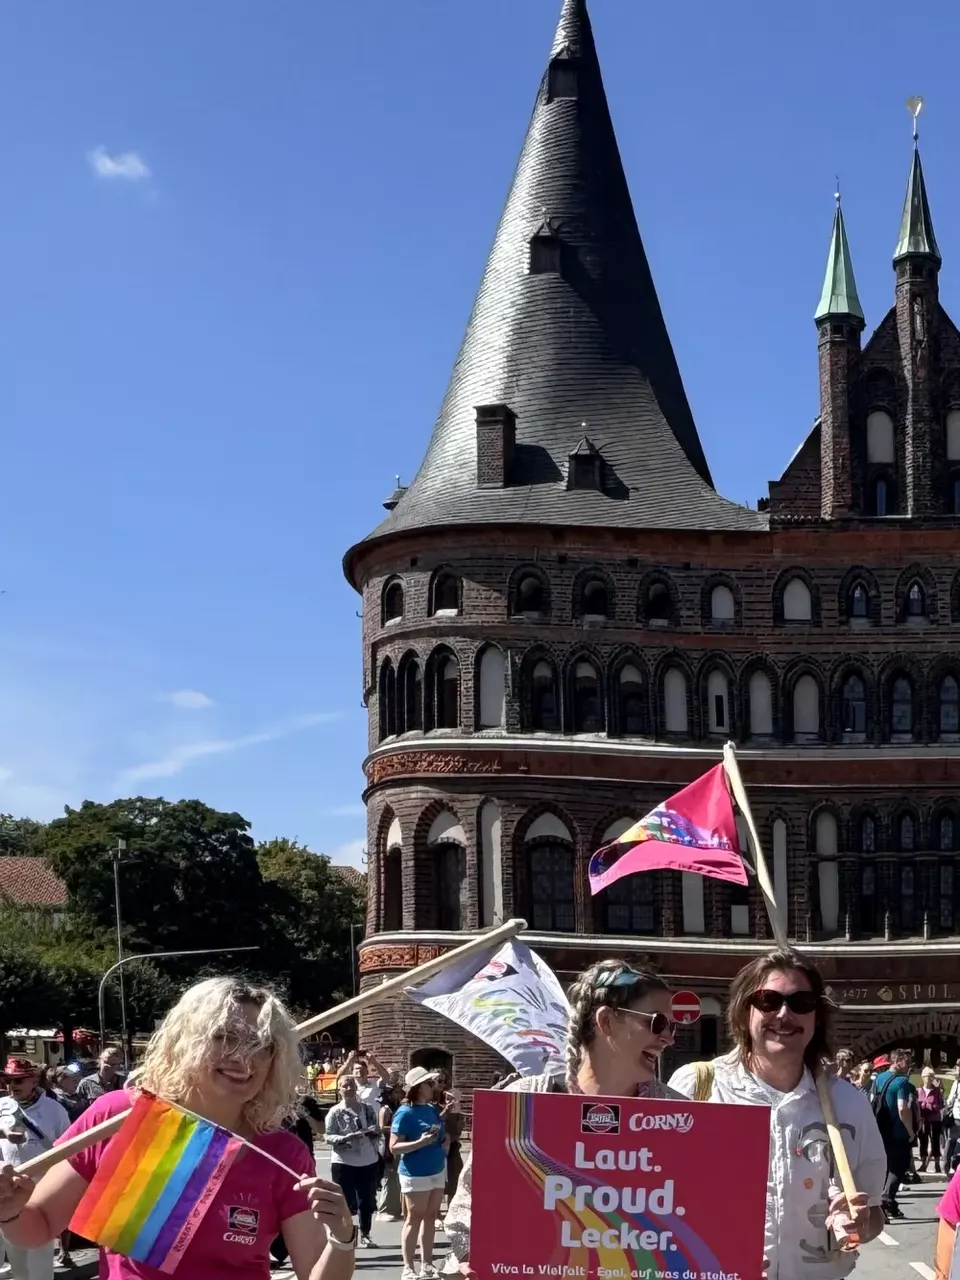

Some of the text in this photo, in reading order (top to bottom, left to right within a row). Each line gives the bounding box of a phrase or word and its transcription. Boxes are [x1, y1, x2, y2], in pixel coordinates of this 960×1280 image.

[629, 1112, 694, 1133] CORNY
[575, 1141, 662, 1173] Laut.
[543, 1174, 686, 1216] Proud.
[561, 1220, 678, 1252] Lecker.
[491, 1263, 519, 1275] Viva
[522, 1264, 535, 1275] la
[538, 1264, 586, 1278] Vielfalt
[597, 1266, 628, 1279] Egal,
[630, 1268, 653, 1280] auf
[655, 1269, 680, 1280] was
[682, 1269, 697, 1280] du
[700, 1270, 742, 1280] stehst.
